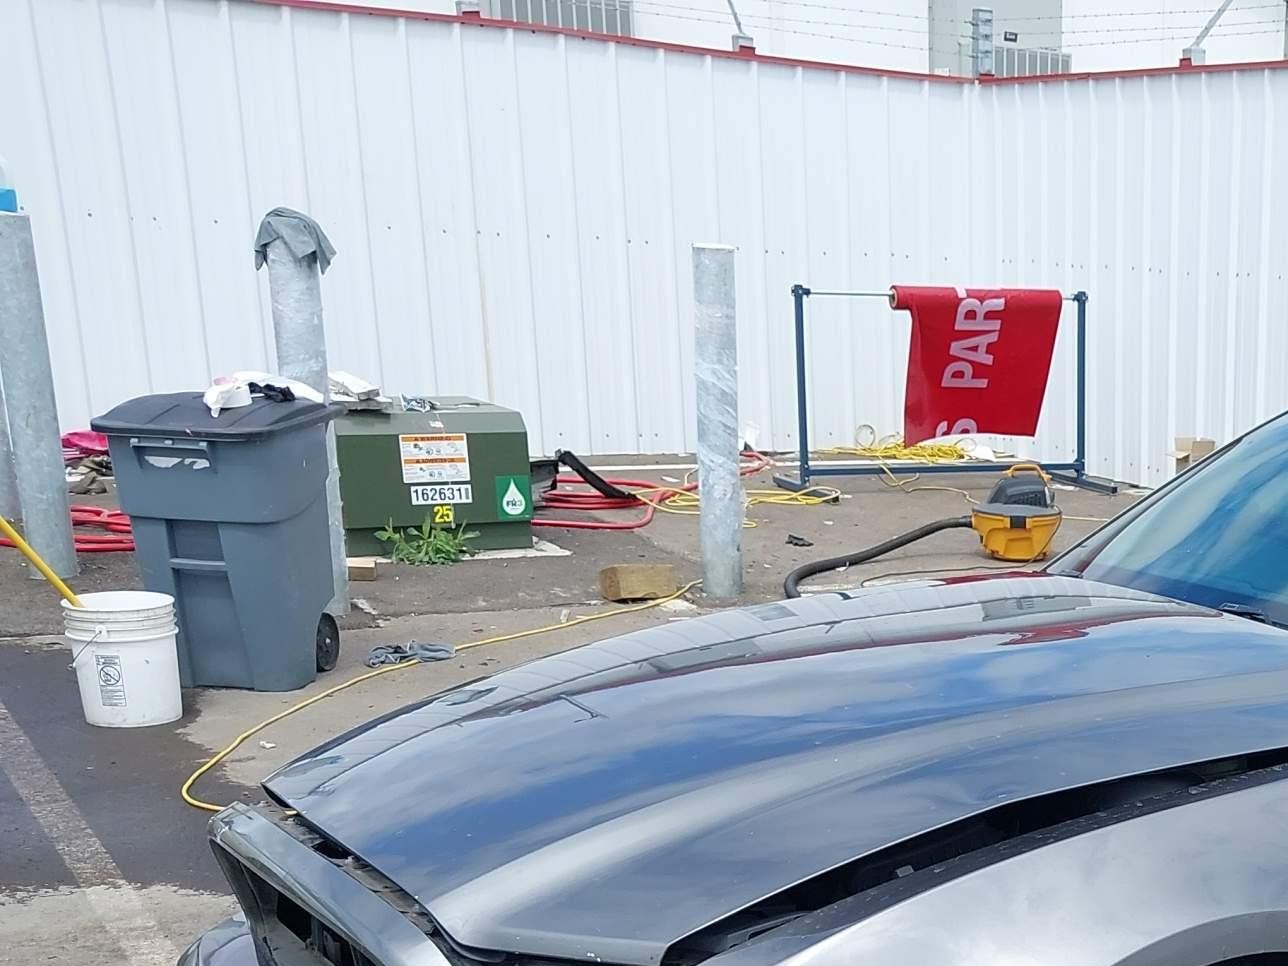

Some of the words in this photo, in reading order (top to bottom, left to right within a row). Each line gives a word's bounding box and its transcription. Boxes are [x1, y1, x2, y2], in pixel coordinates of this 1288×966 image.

[941, 289, 1005, 387] PAR
[412, 487, 463, 502] 162631
[433, 505, 453, 523] 25
